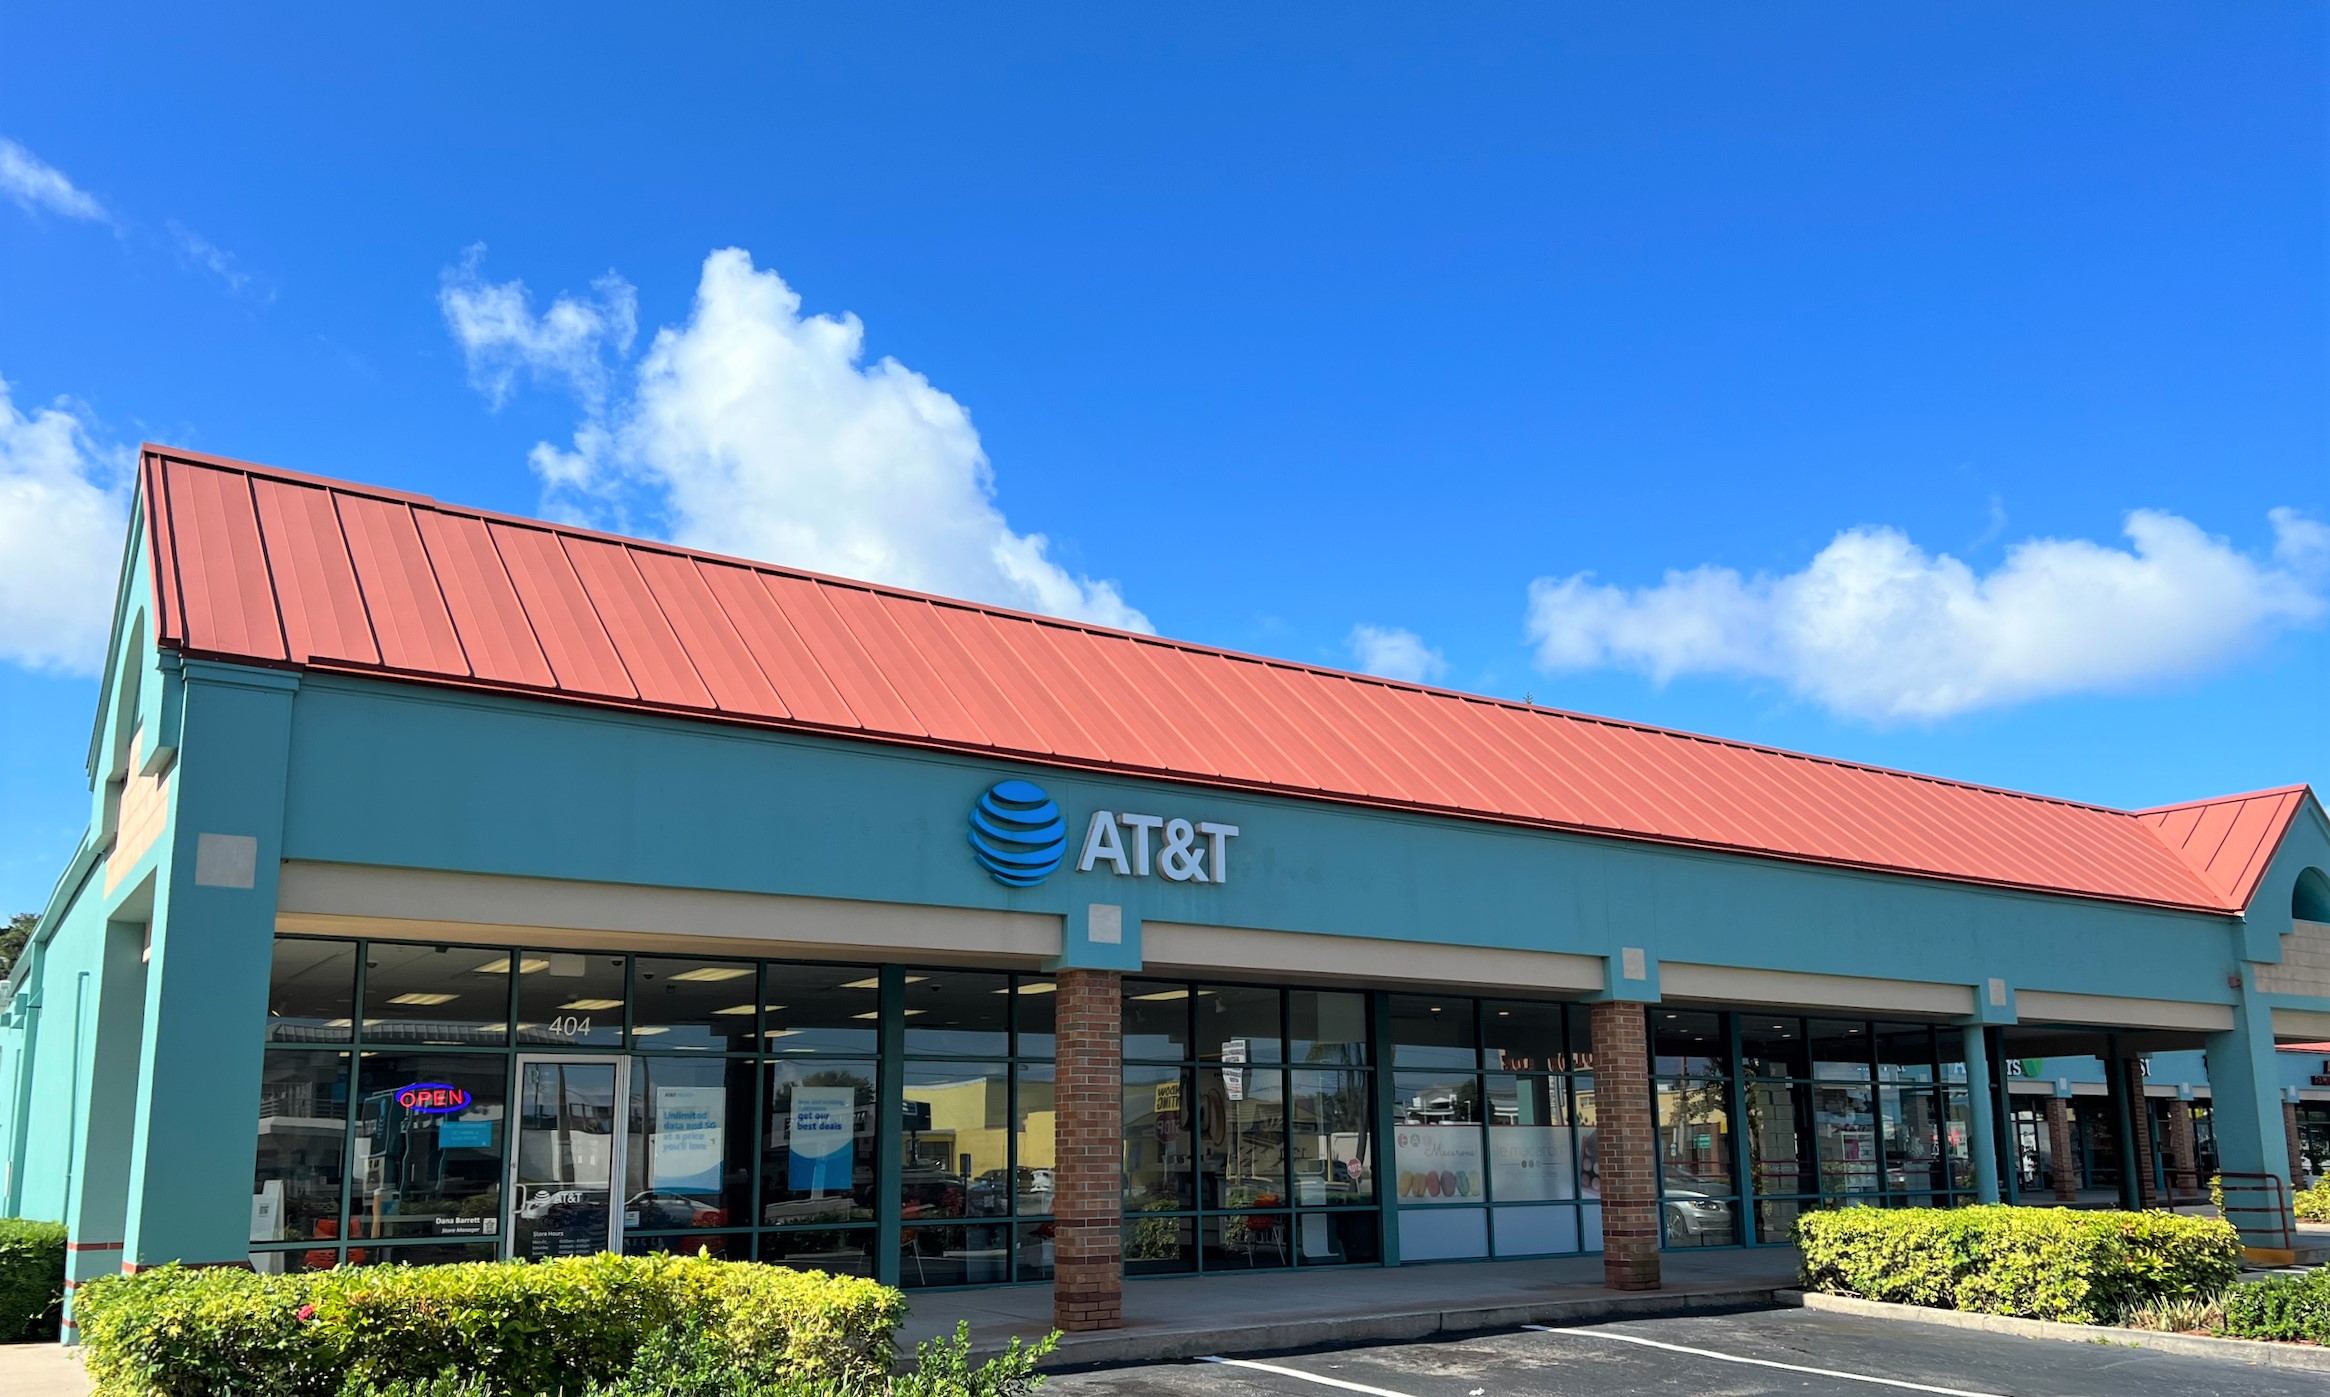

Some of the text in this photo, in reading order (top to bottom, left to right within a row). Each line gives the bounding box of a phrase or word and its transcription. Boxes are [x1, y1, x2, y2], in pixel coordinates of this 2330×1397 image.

[1076, 810, 1239, 884] AT&T
[548, 1016, 591, 1036] 404
[400, 1089, 463, 1108] OPEN
[663, 1111, 708, 1120] Unlimited
[797, 1112, 812, 1121] get
[663, 1122, 684, 1130] data
[686, 1122, 703, 1130] and
[797, 1121, 842, 1130] best deals
[682, 1132, 704, 1142] price
[689, 1142, 707, 1151] love
[553, 1192, 583, 1204] AT&T
[455, 1216, 480, 1224] Barrett
